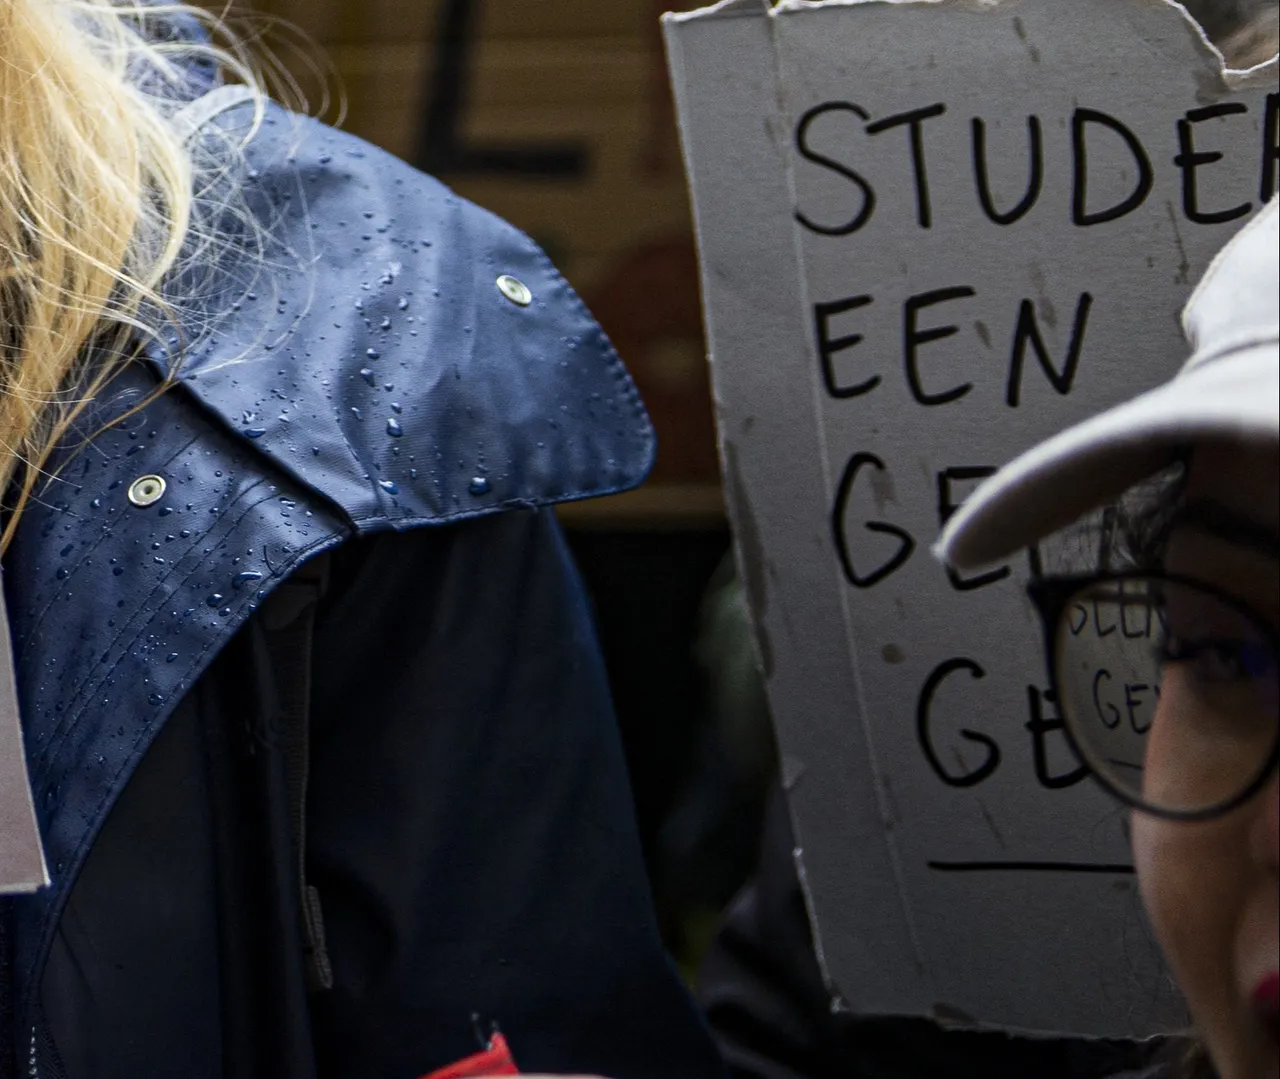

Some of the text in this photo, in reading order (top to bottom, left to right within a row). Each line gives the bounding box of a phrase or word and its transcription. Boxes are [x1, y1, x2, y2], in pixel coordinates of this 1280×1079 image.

[794, 92, 1278, 238] STUDE
[813, 285, 1094, 409] EEN
[915, 656, 1092, 789] GE
